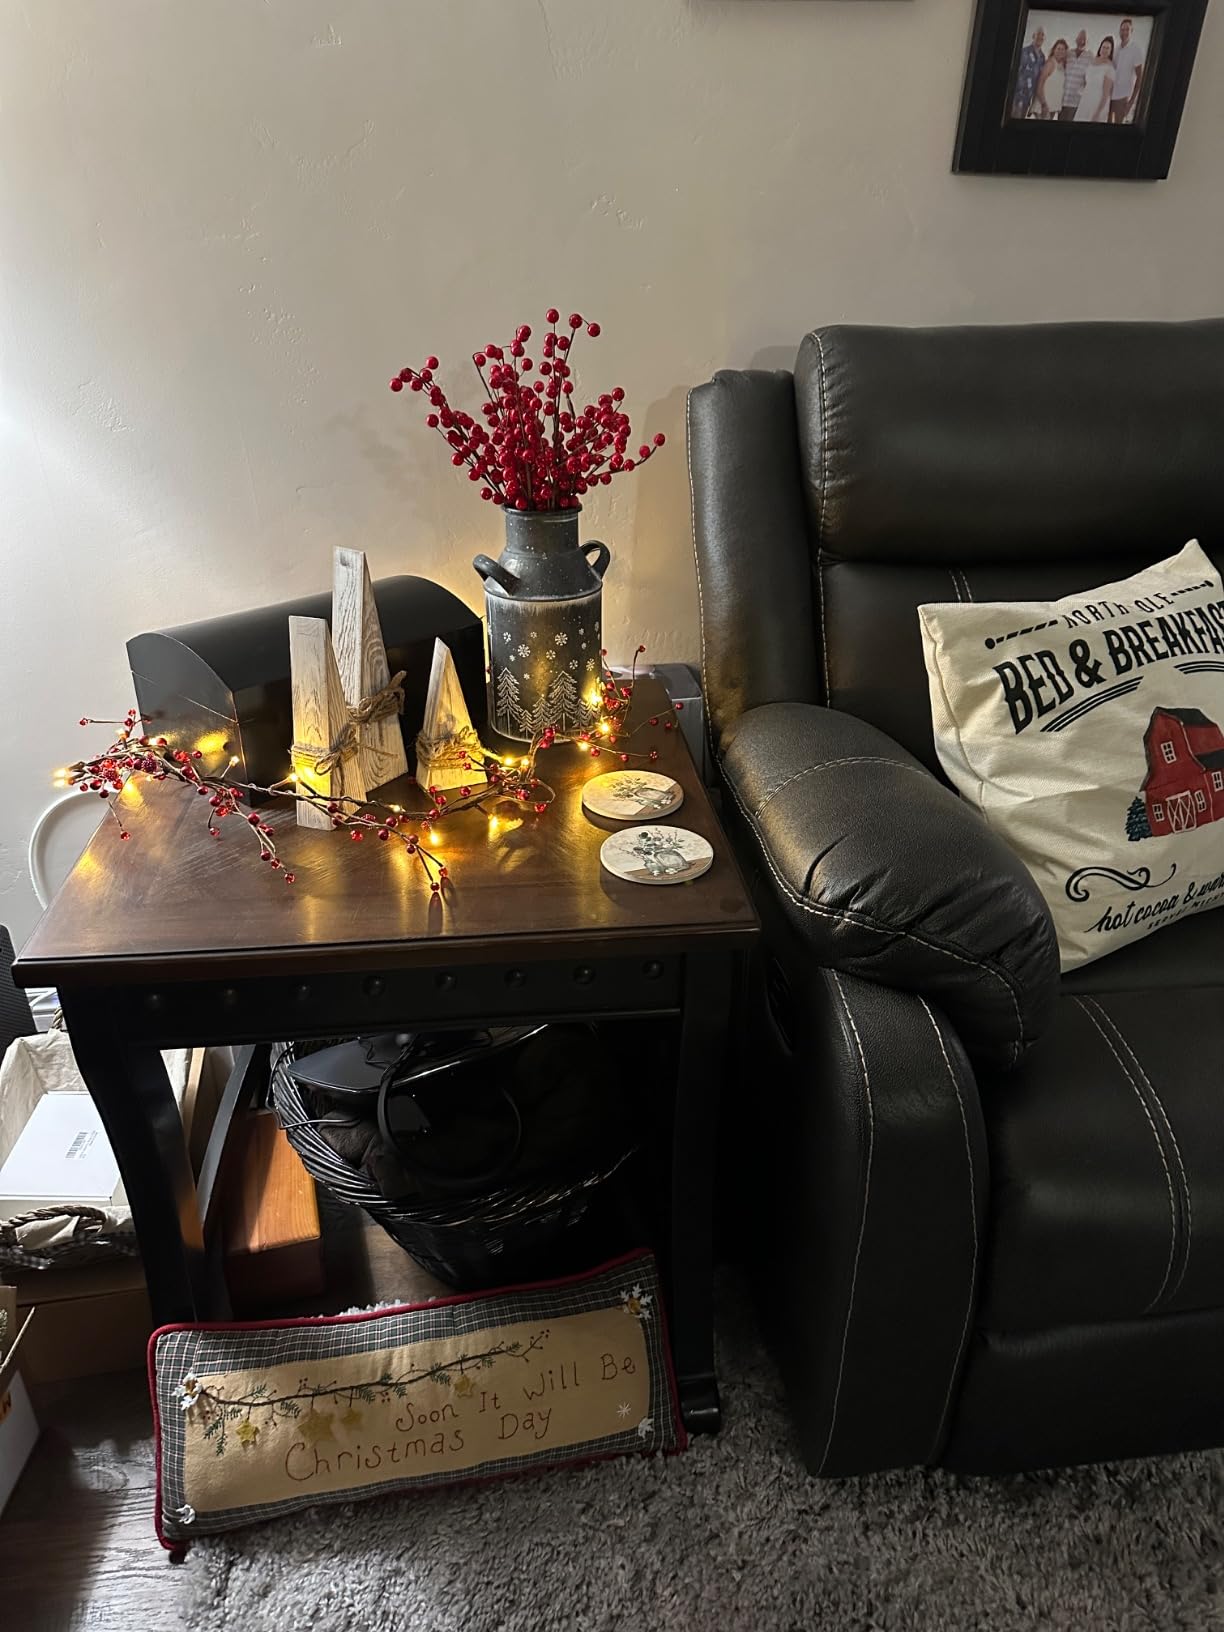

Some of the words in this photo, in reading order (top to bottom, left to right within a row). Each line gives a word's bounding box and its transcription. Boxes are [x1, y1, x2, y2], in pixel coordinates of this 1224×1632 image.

[1133, 592, 1175, 613] OLE
[992, 650, 1075, 735] BED
[1069, 638, 1107, 689] &
[1102, 600, 1224, 676] BREAKFAS
[1083, 901, 1136, 932] hot
[1134, 894, 1179, 924] cocoa
[1182, 881, 1198, 904] &
[395, 1402, 459, 1432] Soon
[479, 1391, 502, 1414] It
[601, 1353, 636, 1381] Be
[285, 1430, 465, 1481] Christmas
[498, 1407, 552, 1440] Day
